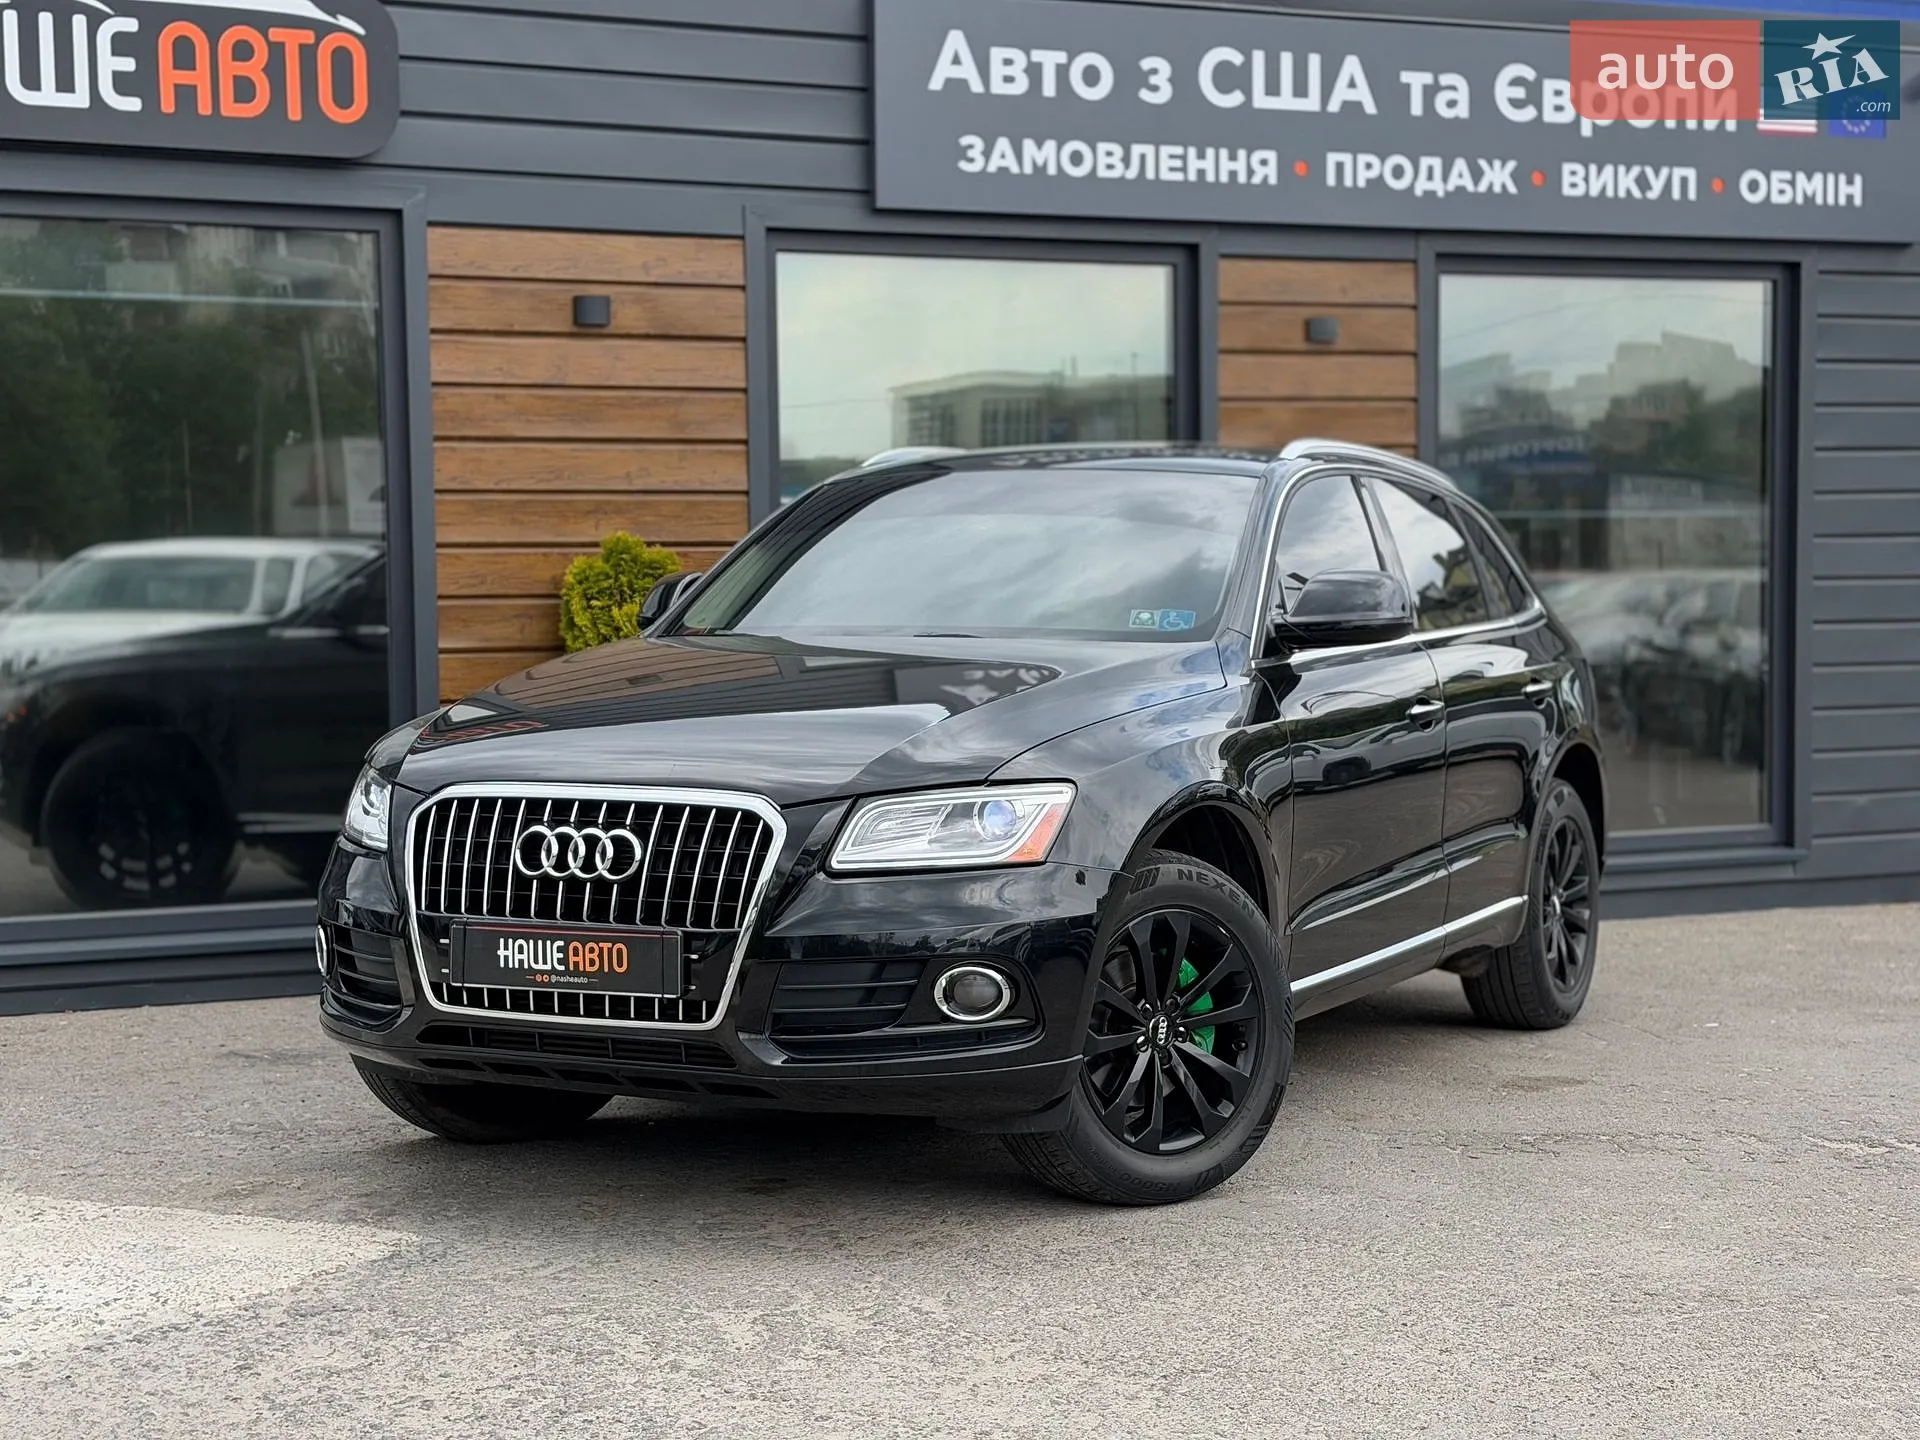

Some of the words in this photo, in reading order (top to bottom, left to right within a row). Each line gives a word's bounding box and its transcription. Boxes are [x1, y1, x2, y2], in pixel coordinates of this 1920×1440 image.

[157, 20, 370, 125] АВТО
[927, 29, 1115, 101] Авто
[1137, 56, 1174, 105] з
[1197, 46, 1379, 115] США
[1400, 70, 1470, 119] та
[1494, 63, 1738, 138] Європи
[957, 135, 1279, 187] ЗАМОВЛЕННЯ
[1325, 151, 1519, 199] ПРОДАЖ
[1561, 162, 1698, 201] ВИКУП
[1739, 169, 1864, 207] ОБМІН
[1177, 868, 1256, 918] NEXEN
[497, 938, 565, 971] НАШЕ
[568, 941, 628, 973] АВТО
[550, 974, 589, 984] @nasheauto
